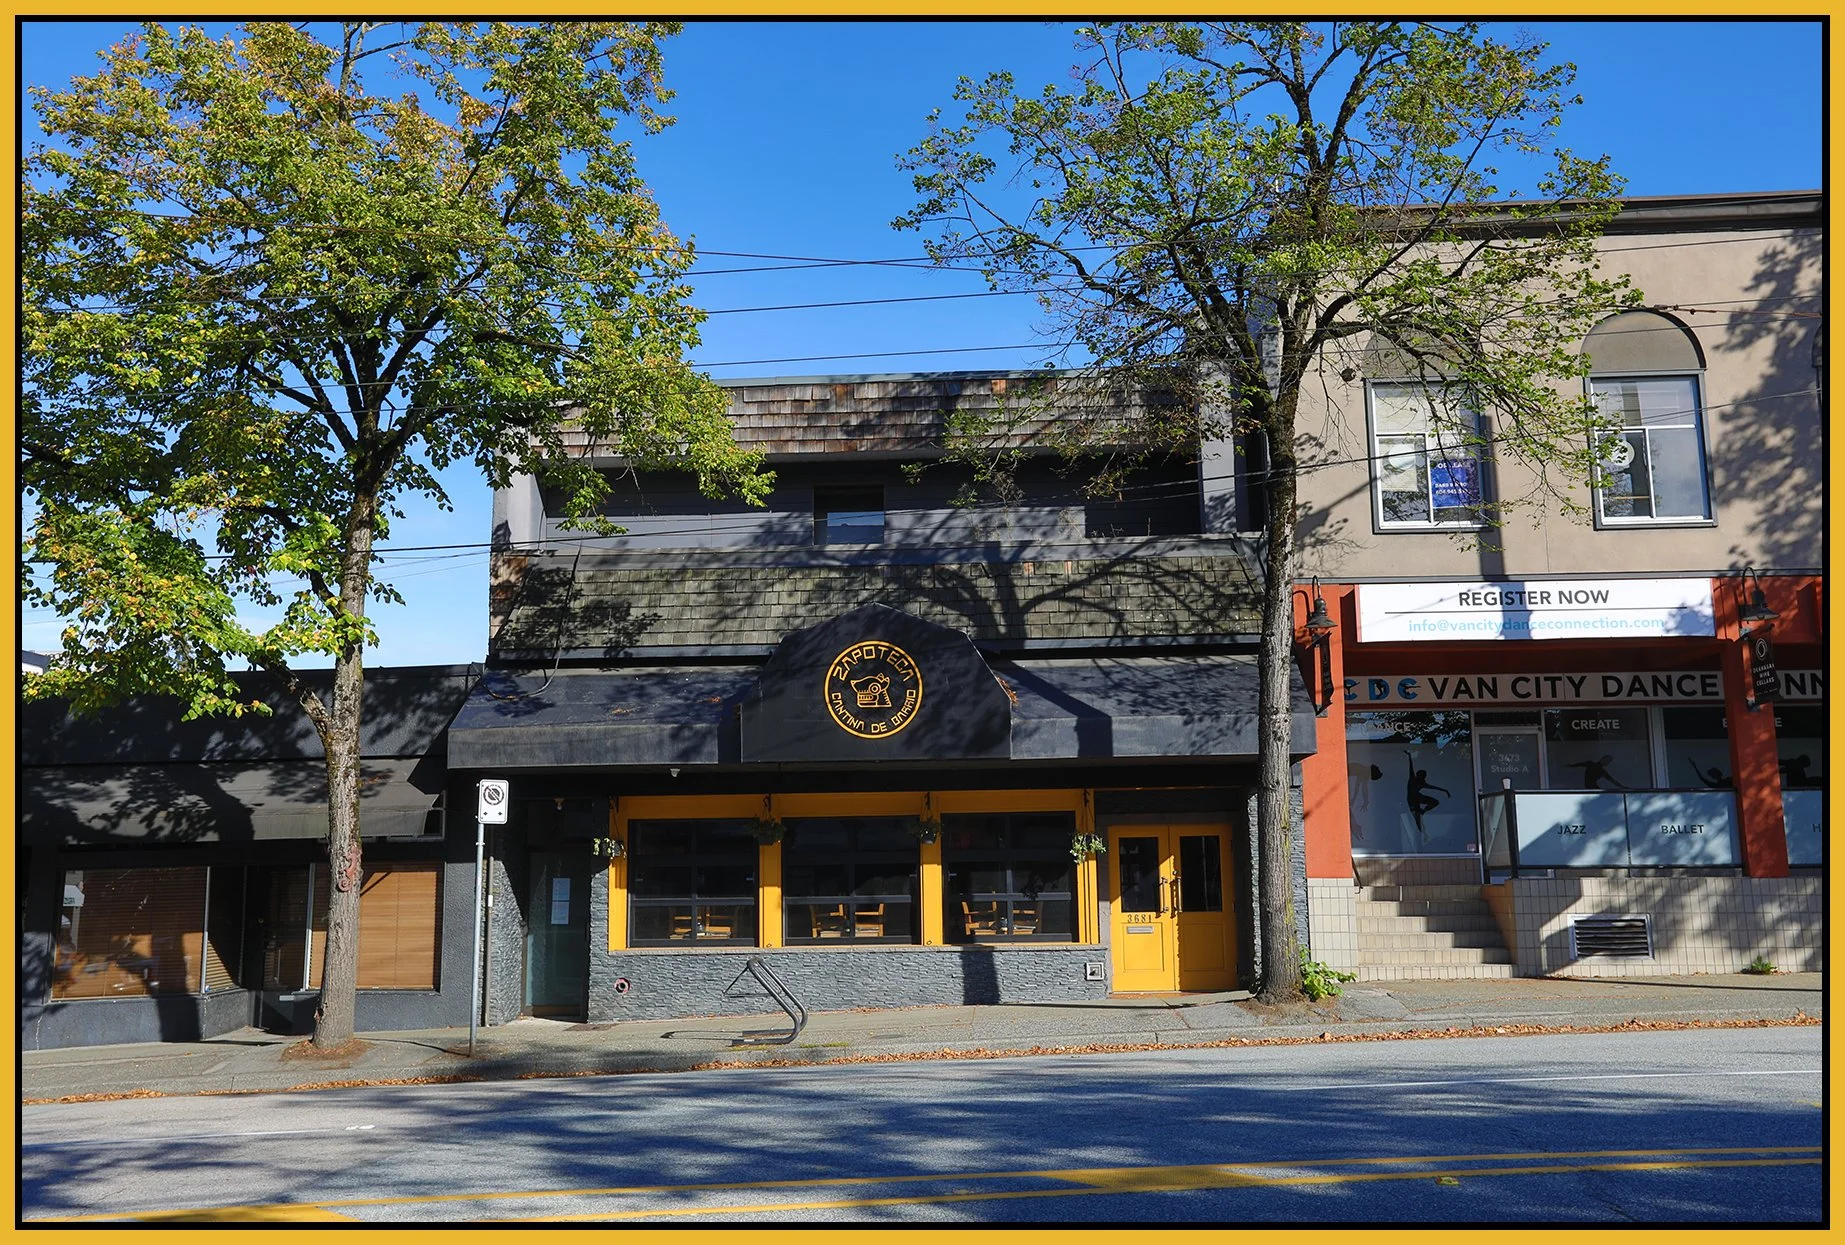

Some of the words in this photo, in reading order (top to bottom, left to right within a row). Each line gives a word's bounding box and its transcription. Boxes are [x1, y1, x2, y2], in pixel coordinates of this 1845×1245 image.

[1459, 590, 1552, 606] REGISTER
[1558, 589, 1610, 605] NOW
[1409, 616, 1665, 633] info@vancitydanceconnection.com
[832, 646, 914, 682] ZAPOTECA
[1428, 677, 1499, 699] VAN
[1511, 676, 1587, 699] CITY
[1601, 674, 1720, 698] DANCE
[831, 692, 865, 731] CANTINA
[871, 721, 888, 733] DE
[890, 689, 916, 726] BARRIO
[1571, 719, 1620, 730] CREATE
[1490, 764, 1519, 773] Studio
[1522, 764, 1530, 773] A
[1557, 824, 1587, 835] JAZZ
[1661, 824, 1705, 834] BALLET
[1127, 913, 1152, 923] 3681
